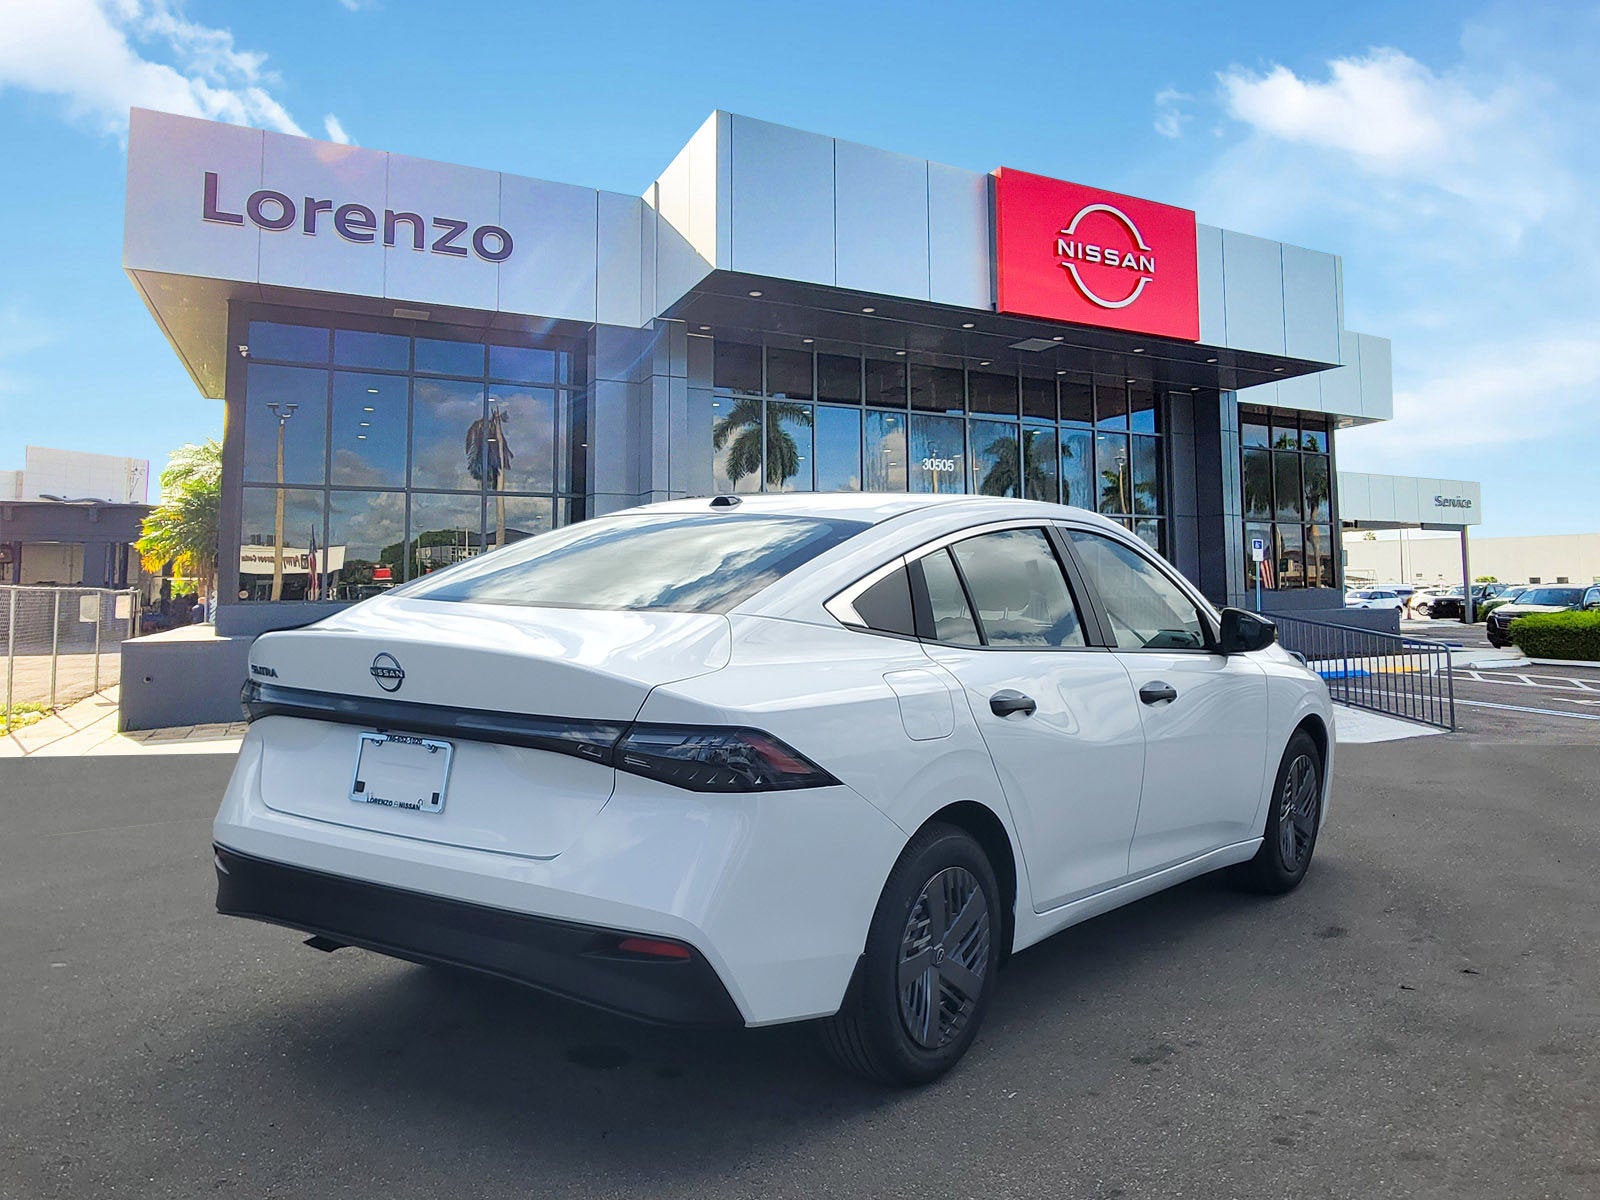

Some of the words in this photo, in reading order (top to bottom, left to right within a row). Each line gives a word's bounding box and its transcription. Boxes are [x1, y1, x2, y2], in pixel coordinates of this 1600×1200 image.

[202, 171, 514, 262] Lorenzo
[1057, 238, 1155, 273] NISSAN
[922, 458, 954, 471] 30505
[1434, 495, 1472, 508] Service
[370, 666, 405, 679] NISSAN
[366, 797, 393, 807] LORENZO
[399, 802, 420, 811] NISSAN
